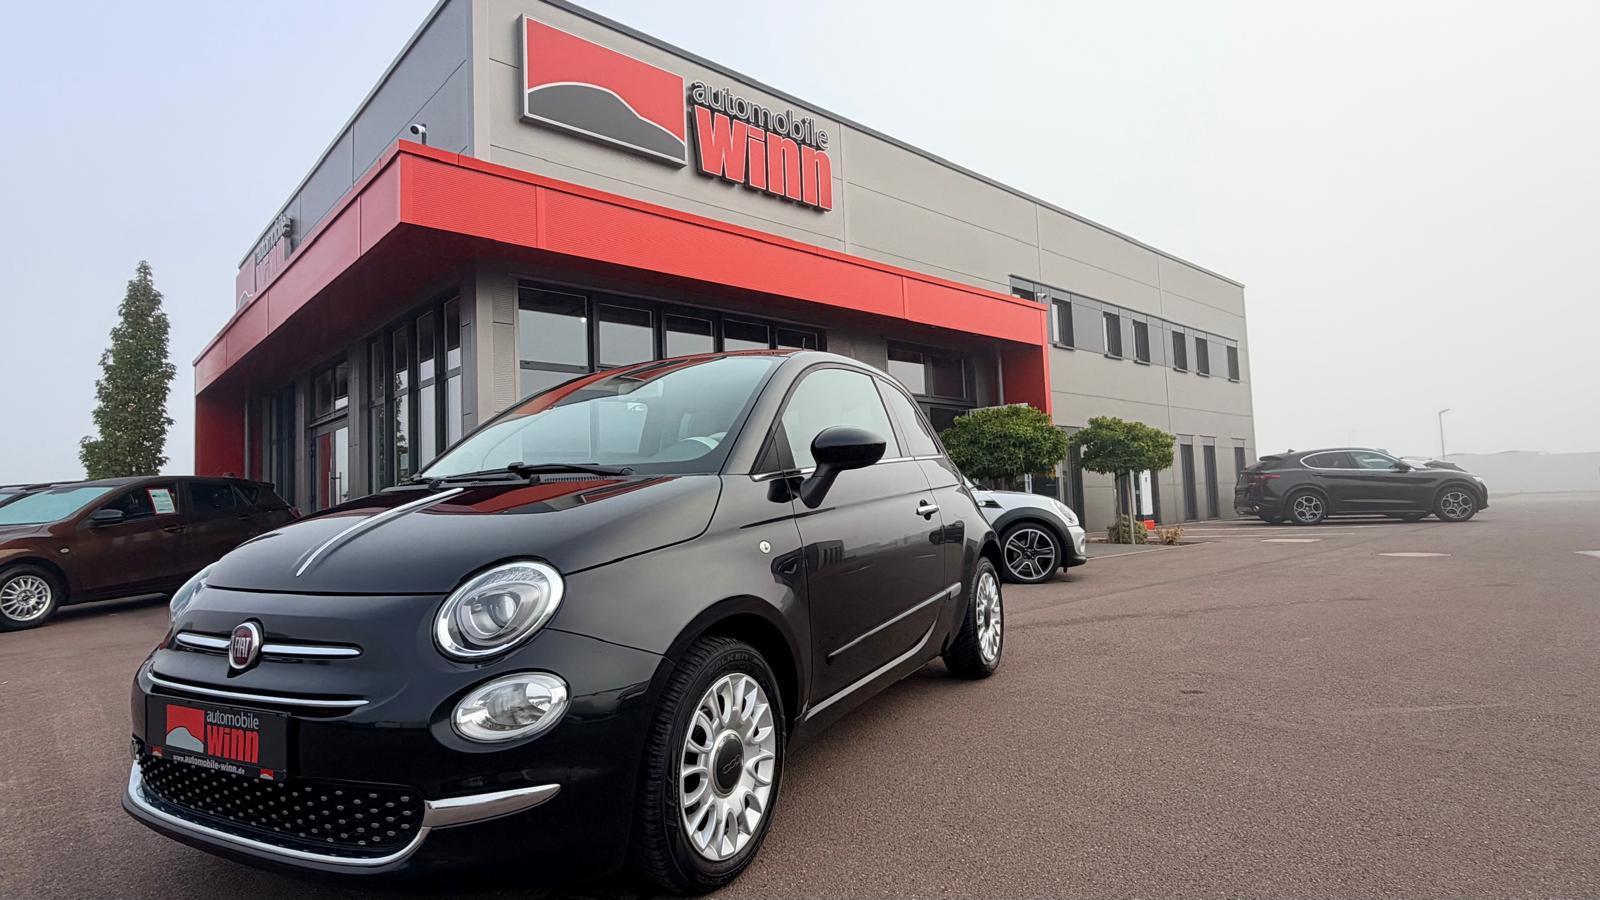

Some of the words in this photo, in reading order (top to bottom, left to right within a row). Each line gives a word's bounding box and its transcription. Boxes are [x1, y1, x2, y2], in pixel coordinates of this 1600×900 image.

[692, 80, 829, 149] automobile
[233, 636, 252, 658] FIAT
[206, 709, 260, 730] automobile
[173, 755, 246, 775] www.automobile-winn.de
